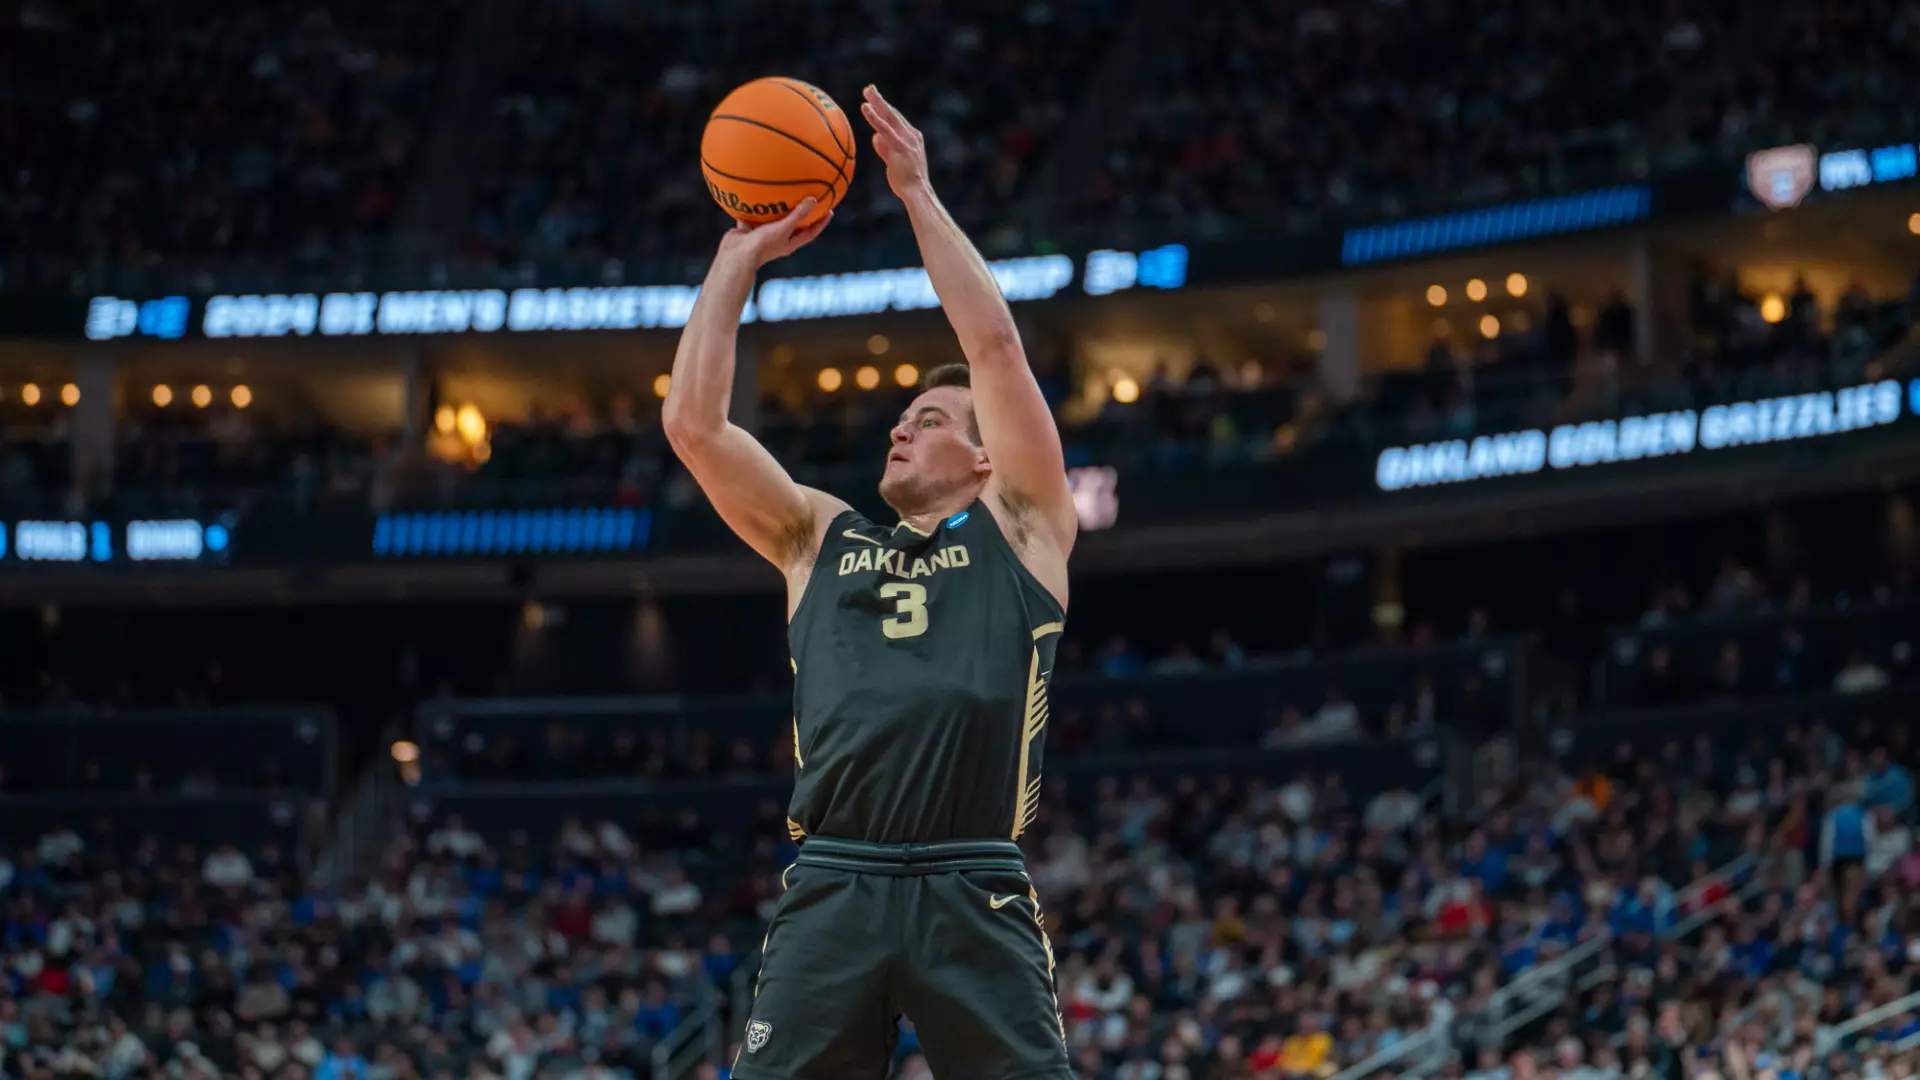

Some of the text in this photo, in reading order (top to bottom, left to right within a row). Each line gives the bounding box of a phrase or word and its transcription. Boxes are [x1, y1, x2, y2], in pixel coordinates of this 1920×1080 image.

[203, 294, 319, 338] 2024
[376, 289, 507, 334] MEN'S
[1376, 379, 1901, 491] OAKLAND GOLDEN GRIZZLIES
[838, 545, 970, 579] OAKLAND
[880, 582, 929, 639] 3
